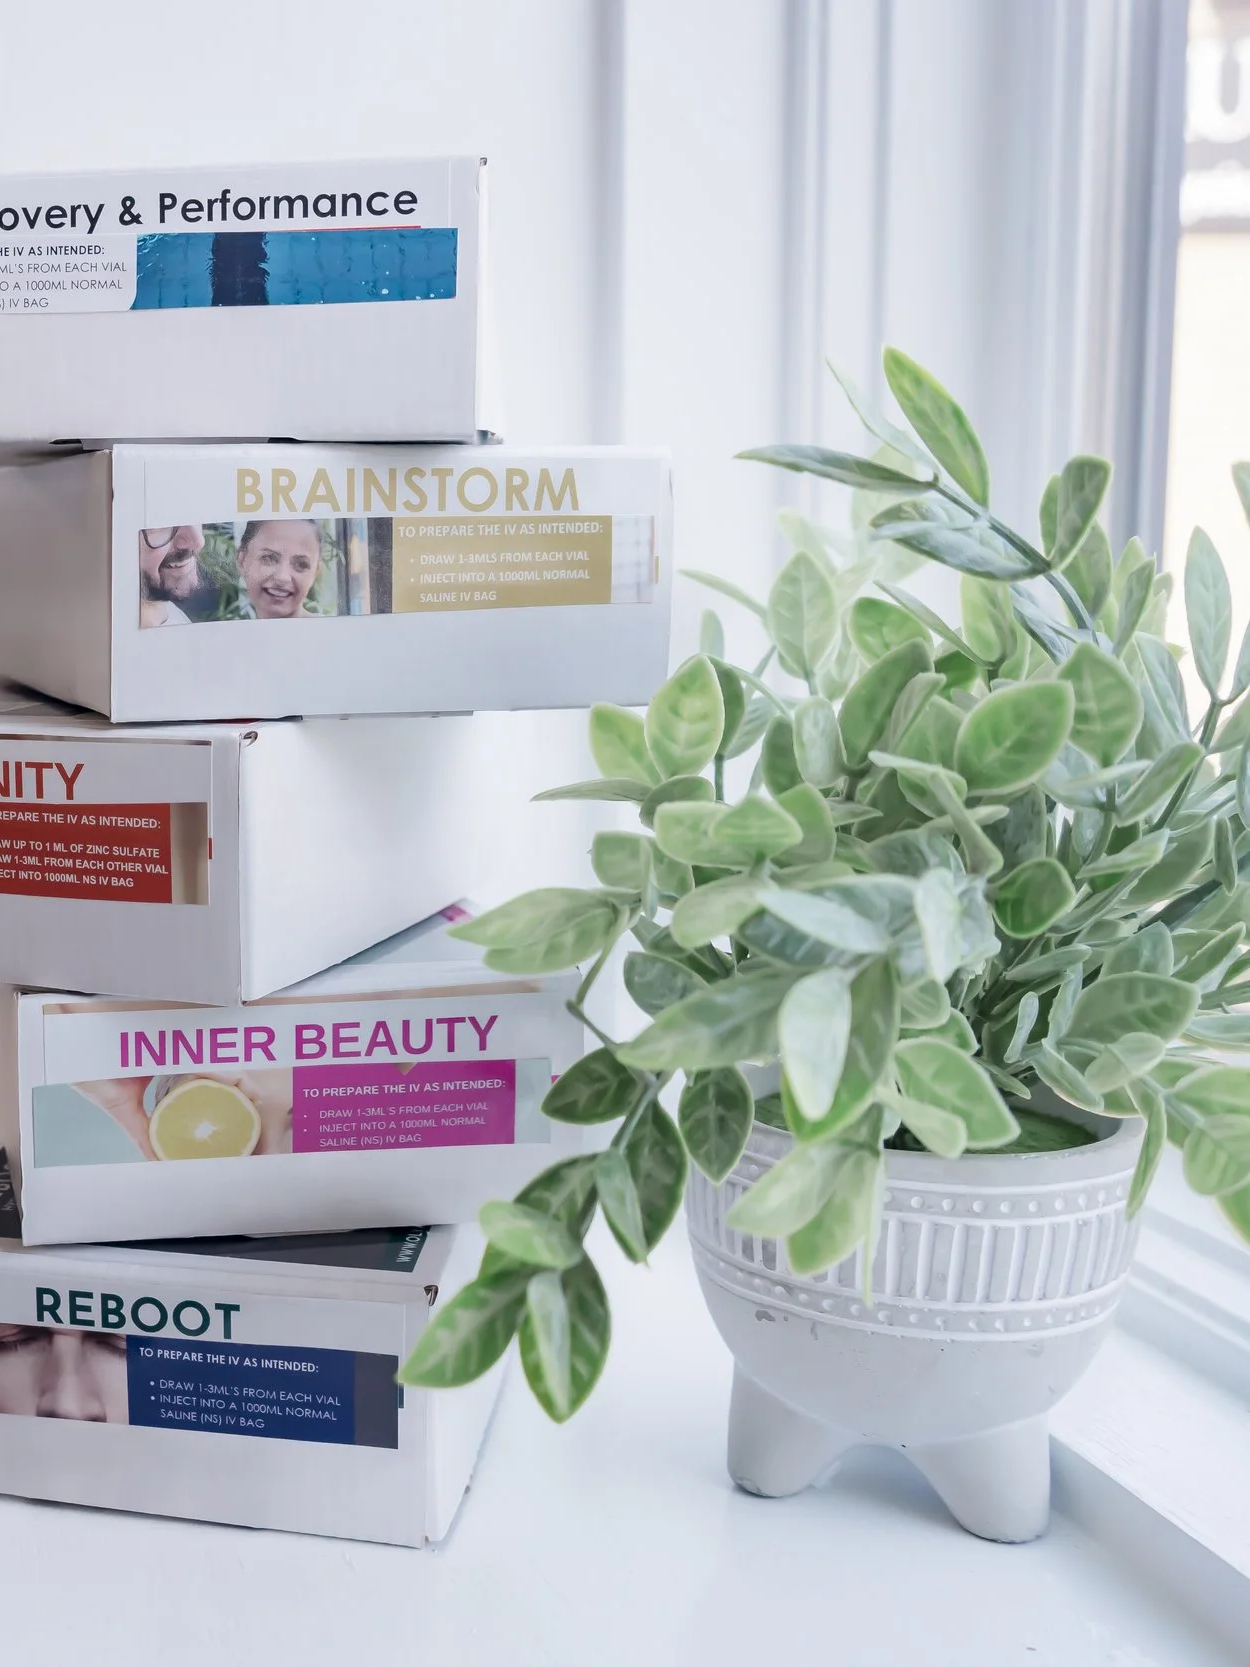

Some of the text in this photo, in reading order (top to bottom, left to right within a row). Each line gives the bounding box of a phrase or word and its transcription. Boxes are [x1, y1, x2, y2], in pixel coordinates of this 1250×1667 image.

[118, 196, 143, 225] &
[158, 189, 418, 223] Performance
[14, 247, 24, 256] IV
[28, 247, 42, 256] AS
[46, 246, 105, 255] INTENDED:
[27, 263, 61, 273] FROM
[65, 263, 98, 272] EACH
[101, 262, 127, 271] VIAL
[13, 281, 21, 290] A
[26, 280, 67, 290] 1000ML
[71, 280, 122, 290] NORMAL
[9, 299, 20, 308] IV
[24, 298, 49, 307] BAG
[236, 467, 579, 513] BRAINSTORM
[398, 522, 603, 538] TO PREPARE THE IV AS INTENDED:
[420, 552, 589, 565] DRAW 1-3MLS FROM EACH VIAL
[420, 570, 589, 583] INJECT INTO A 1000ML NORMAL
[420, 591, 496, 602] SALINE IV BAG
[42, 813, 64, 823] THE
[67, 815, 77, 824] IV
[81, 815, 96, 825] AS
[100, 817, 161, 829] INTENDED:
[14, 840, 26, 849] UP
[29, 841, 42, 850] TO
[46, 843, 50, 851] 1
[54, 843, 67, 852] ML
[70, 844, 83, 853] OF
[87, 845, 109, 854] ZINC
[113, 846, 159, 858] SULFATE
[14, 856, 42, 866] 1-3ML
[44, 857, 73, 868] FROM
[76, 860, 103, 870] EACH
[107, 862, 142, 872] OTHER
[145, 864, 168, 874] VIAL
[19, 871, 41, 880] INTO
[44, 873, 80, 883] 1000ML
[83, 876, 96, 884] NS
[99, 877, 109, 885] IV
[112, 878, 134, 887] BAG
[120, 1015, 498, 1067] INNER BEAUTY
[303, 1079, 506, 1098] TO PREPARE THE IV AS INTENDED:
[319, 1109, 353, 1119] DRAW
[399, 1105, 431, 1114] FROM
[434, 1104, 463, 1113] EACH
[466, 1102, 488, 1110] VIAL
[319, 1117, 486, 1133] INJECT INTO A 1000ML NORMAL
[319, 1134, 422, 1147] SALINE (NS) IV BAG
[36, 1287, 240, 1339] REBOOT
[139, 1348, 319, 1373] TO PREPARE THE IV AS INTENDED:
[160, 1380, 341, 1406] DRAW 1-3ML'S FROM EACH VIAL
[160, 1394, 337, 1420] INJECT INTO A 1000ML NORMAL
[160, 1408, 264, 1428] SALINE (NS) IV BAG
